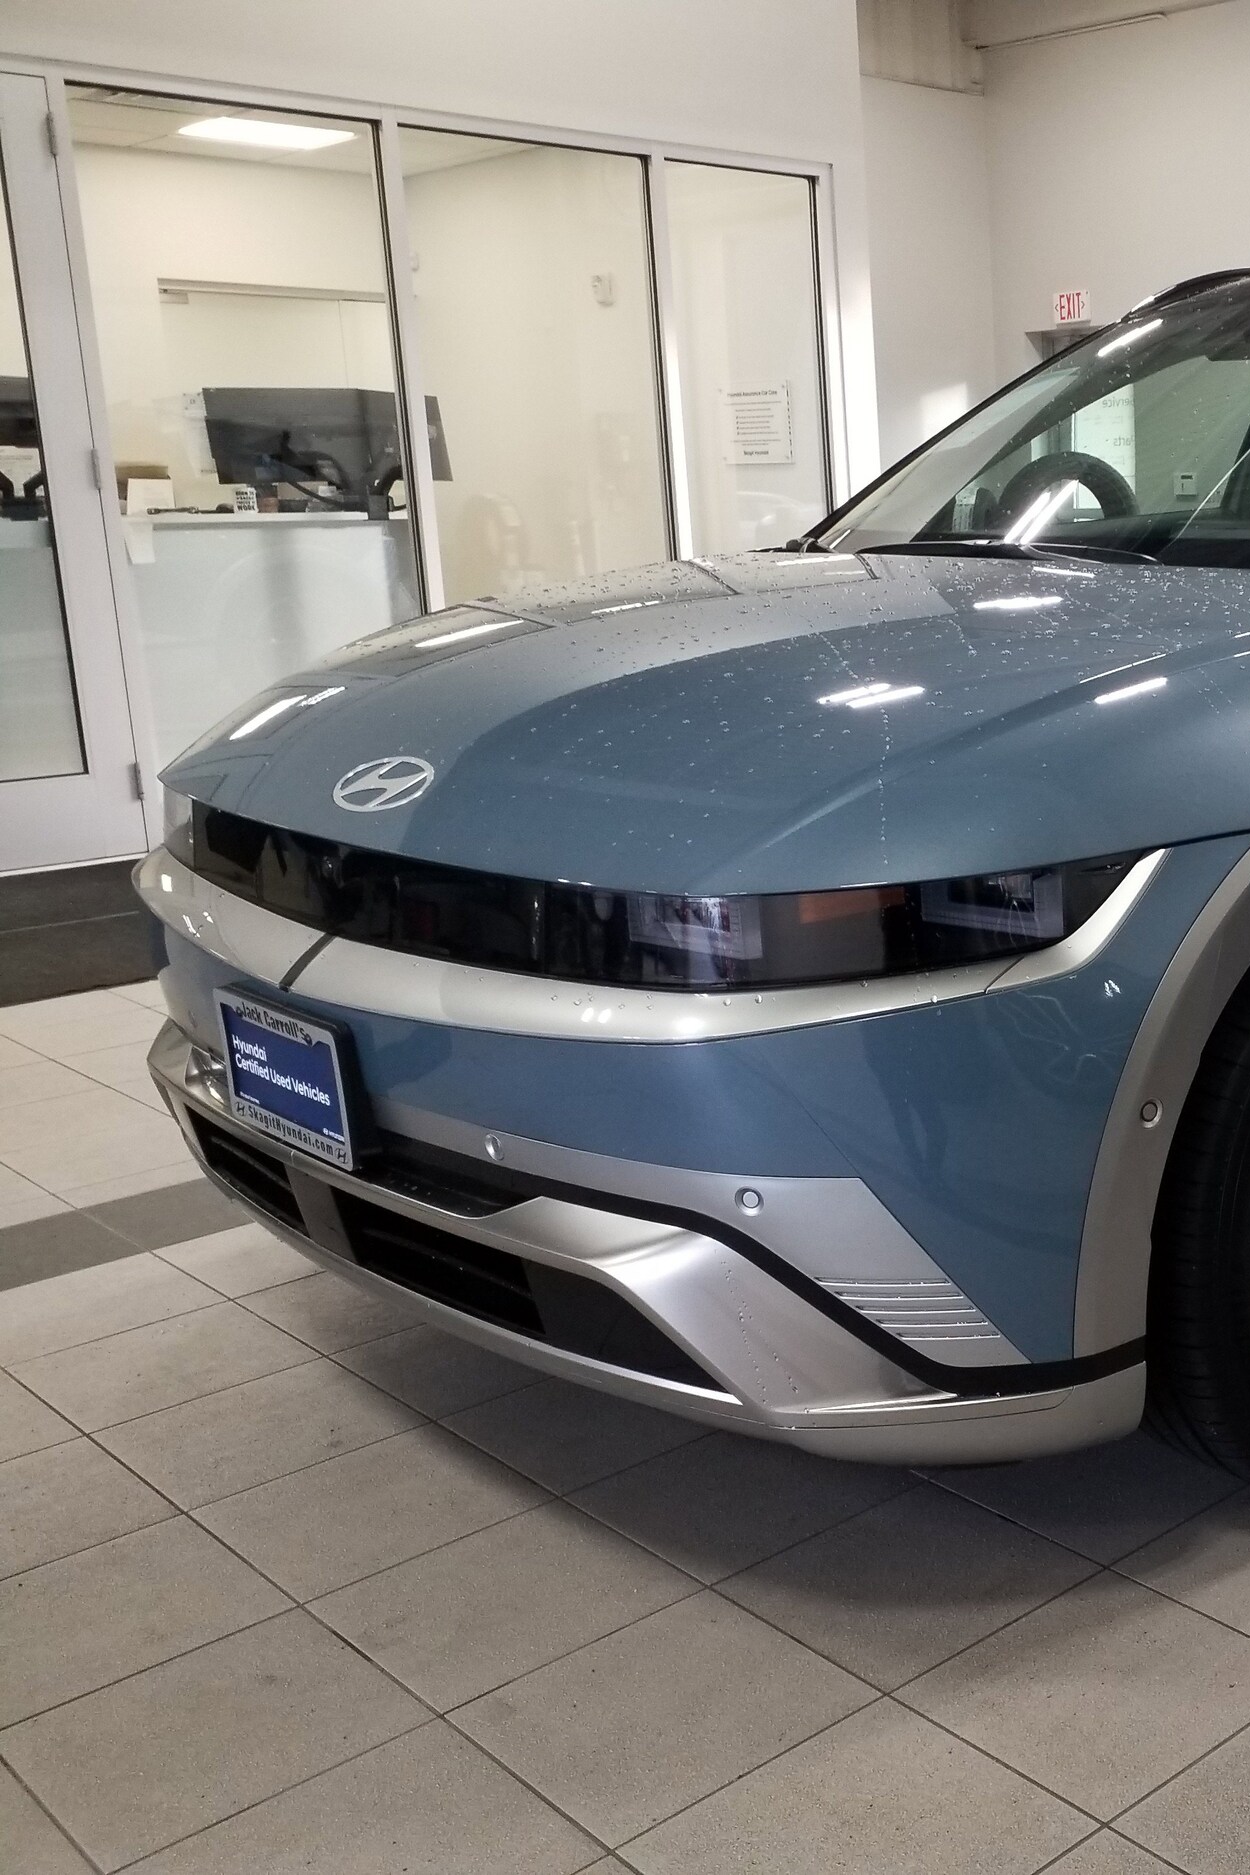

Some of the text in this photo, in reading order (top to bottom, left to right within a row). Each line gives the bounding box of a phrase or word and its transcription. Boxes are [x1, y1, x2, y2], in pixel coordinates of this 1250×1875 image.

[1059, 292, 1081, 320] EXIT
[242, 1002, 308, 1041] Jack Carroll's
[232, 1034, 268, 1062] Hyundai
[235, 1053, 270, 1081] Certified
[269, 1067, 292, 1091] Used
[291, 1077, 331, 1106] Vehicles
[248, 1105, 334, 1156] SkagitHyundai.com
